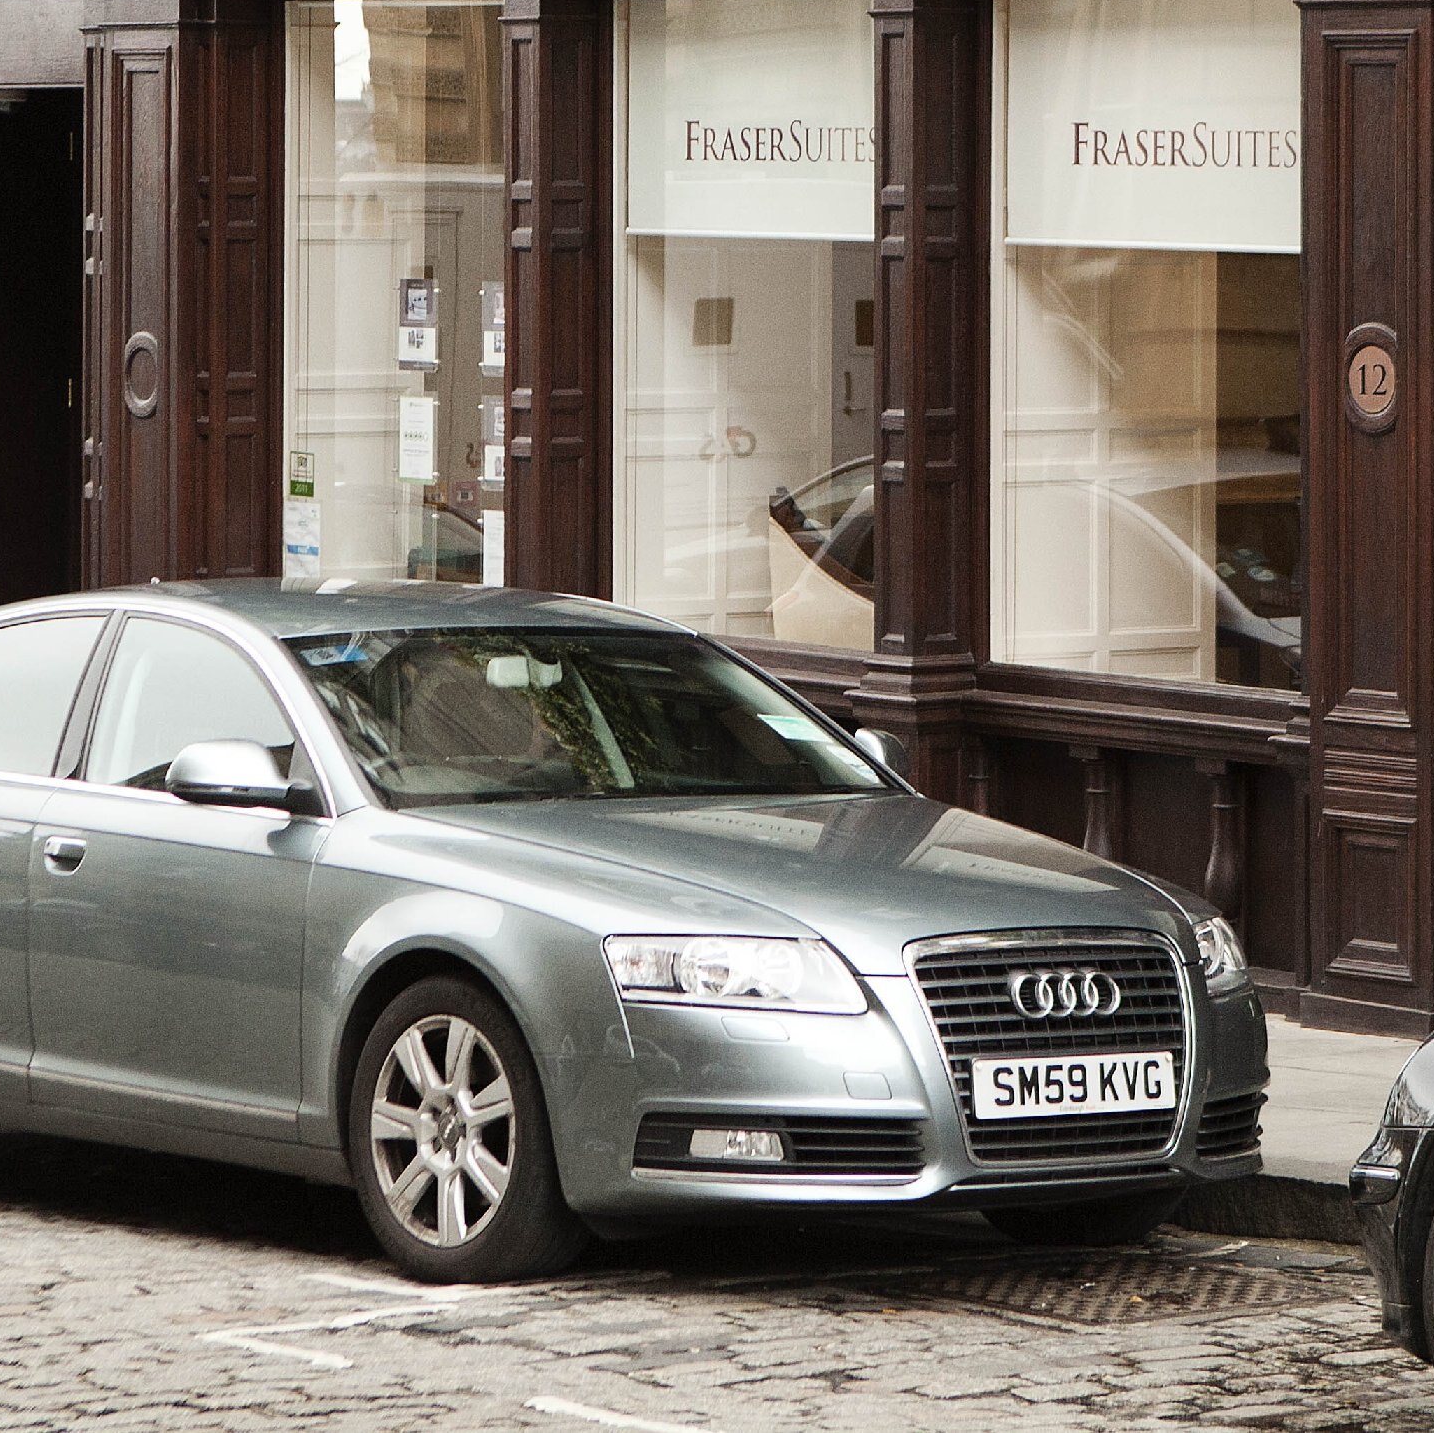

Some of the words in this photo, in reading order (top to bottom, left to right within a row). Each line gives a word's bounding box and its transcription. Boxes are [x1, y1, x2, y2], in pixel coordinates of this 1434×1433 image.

[1071, 121, 1297, 168] FRASERSUITES
[1357, 364, 1387, 396] 12
[992, 1064, 1088, 1107] SM59
[1099, 1060, 1163, 1101] KVG
